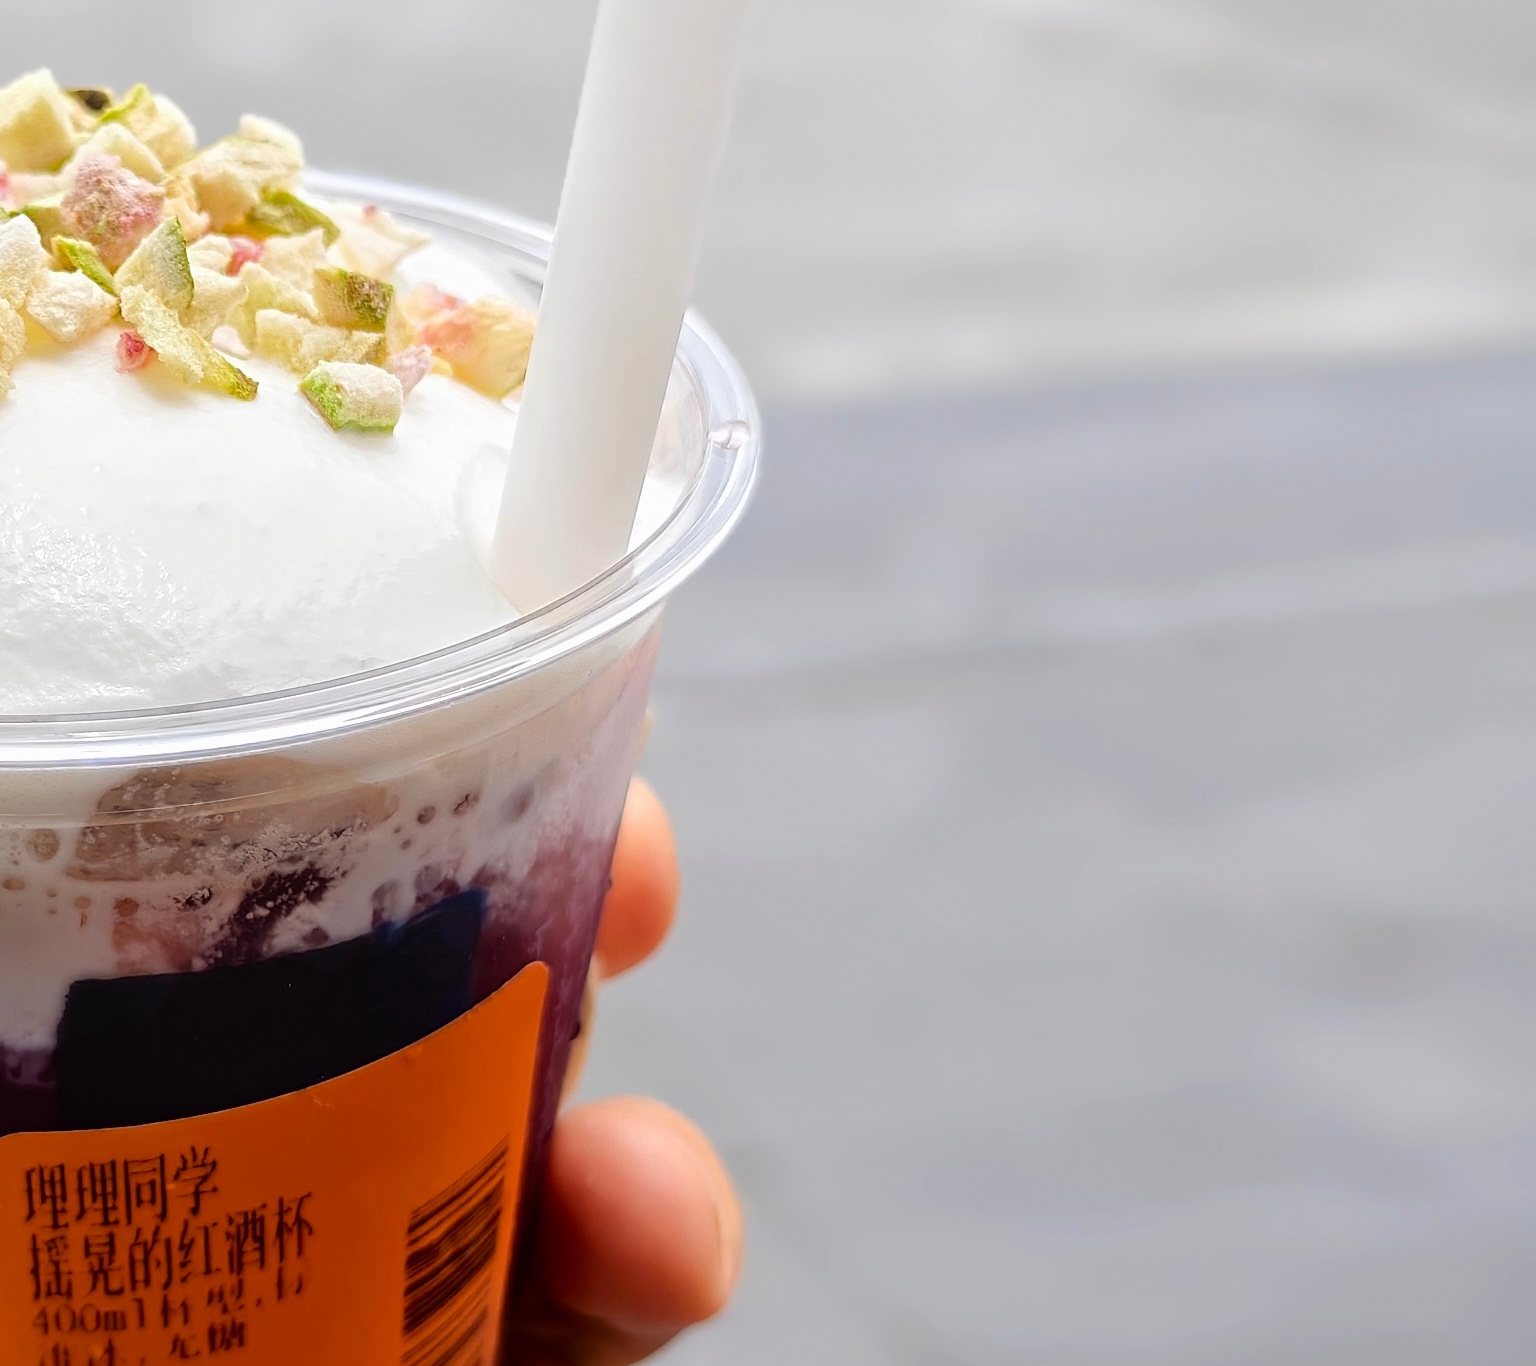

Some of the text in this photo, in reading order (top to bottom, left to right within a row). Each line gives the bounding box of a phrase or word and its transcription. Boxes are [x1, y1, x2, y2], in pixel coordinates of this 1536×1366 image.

[25, 1146, 218, 1229] 理理同学
[31, 1191, 313, 1300] 摇晃的红酒杯
